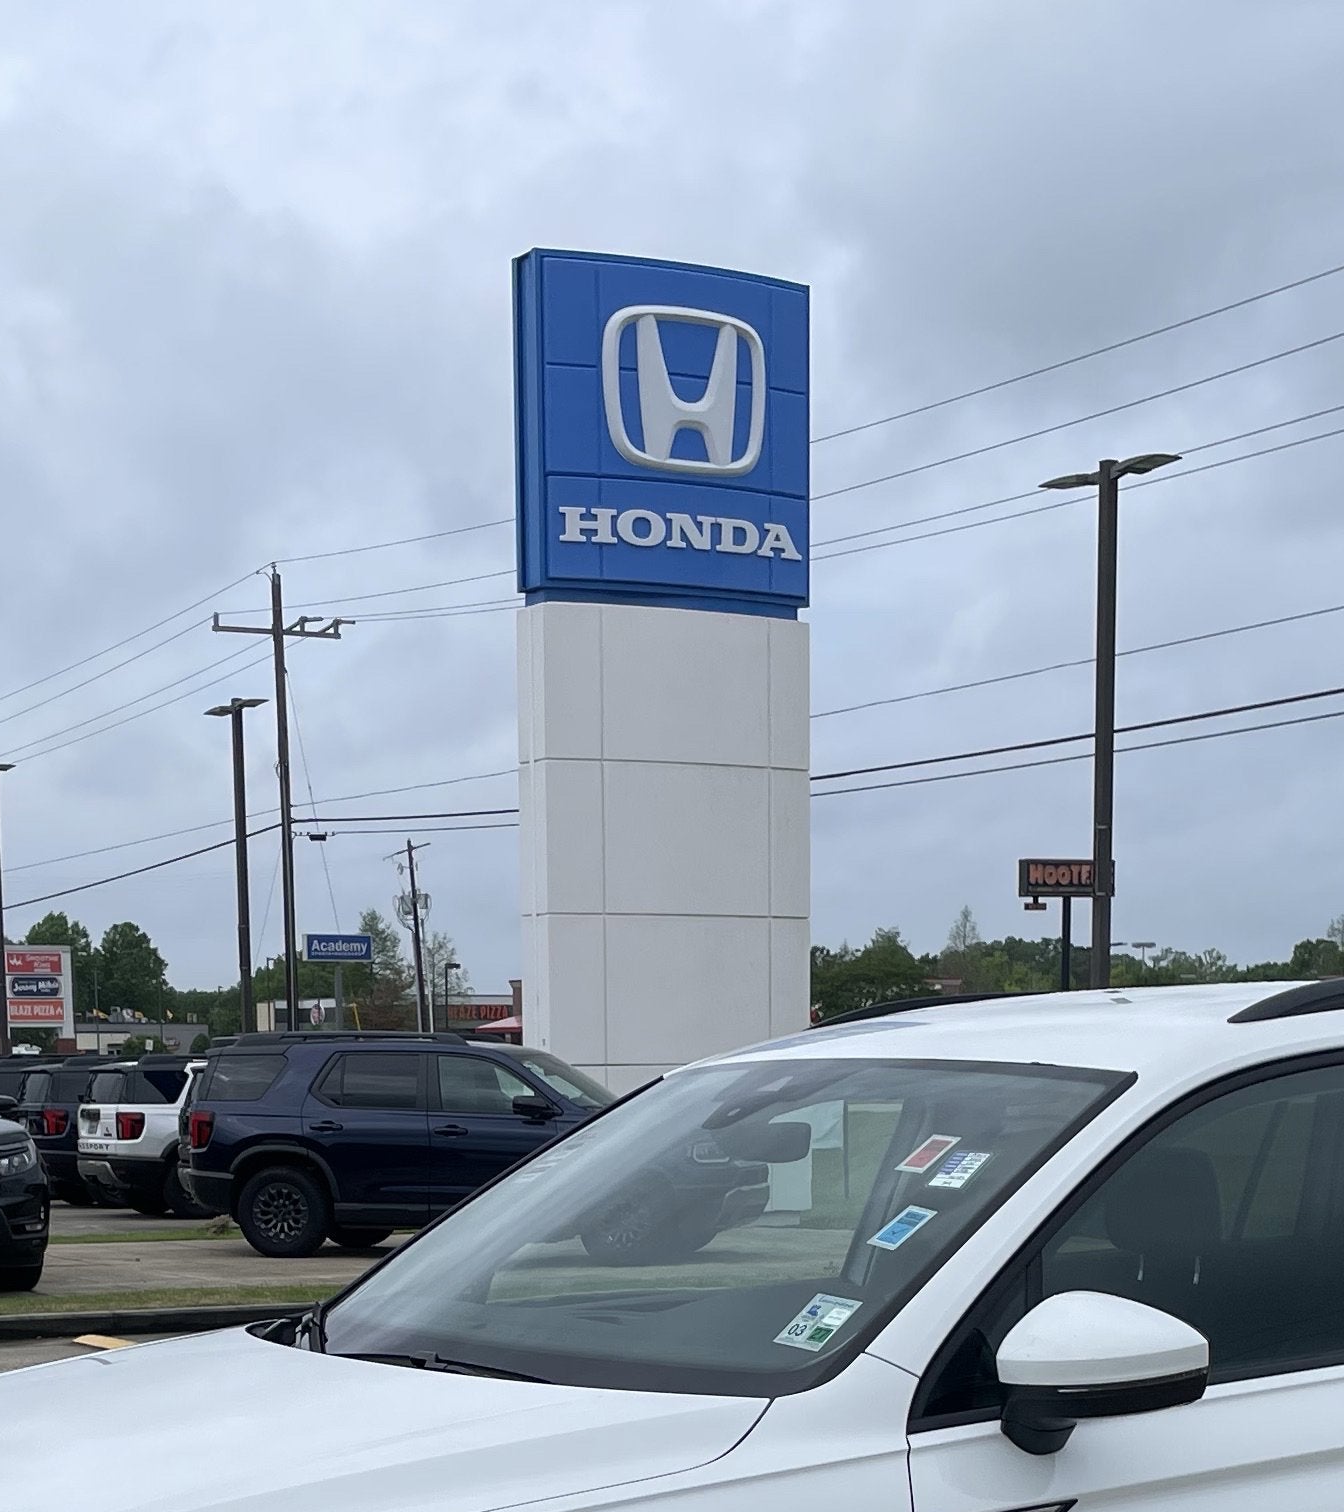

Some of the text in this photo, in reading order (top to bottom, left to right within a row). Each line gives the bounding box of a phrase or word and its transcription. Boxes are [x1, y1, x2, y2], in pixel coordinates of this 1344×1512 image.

[558, 506, 803, 561] HONDA
[1028, 863, 1094, 885] HOOTE
[312, 939, 368, 955] Academy
[787, 1323, 808, 1337] 03
